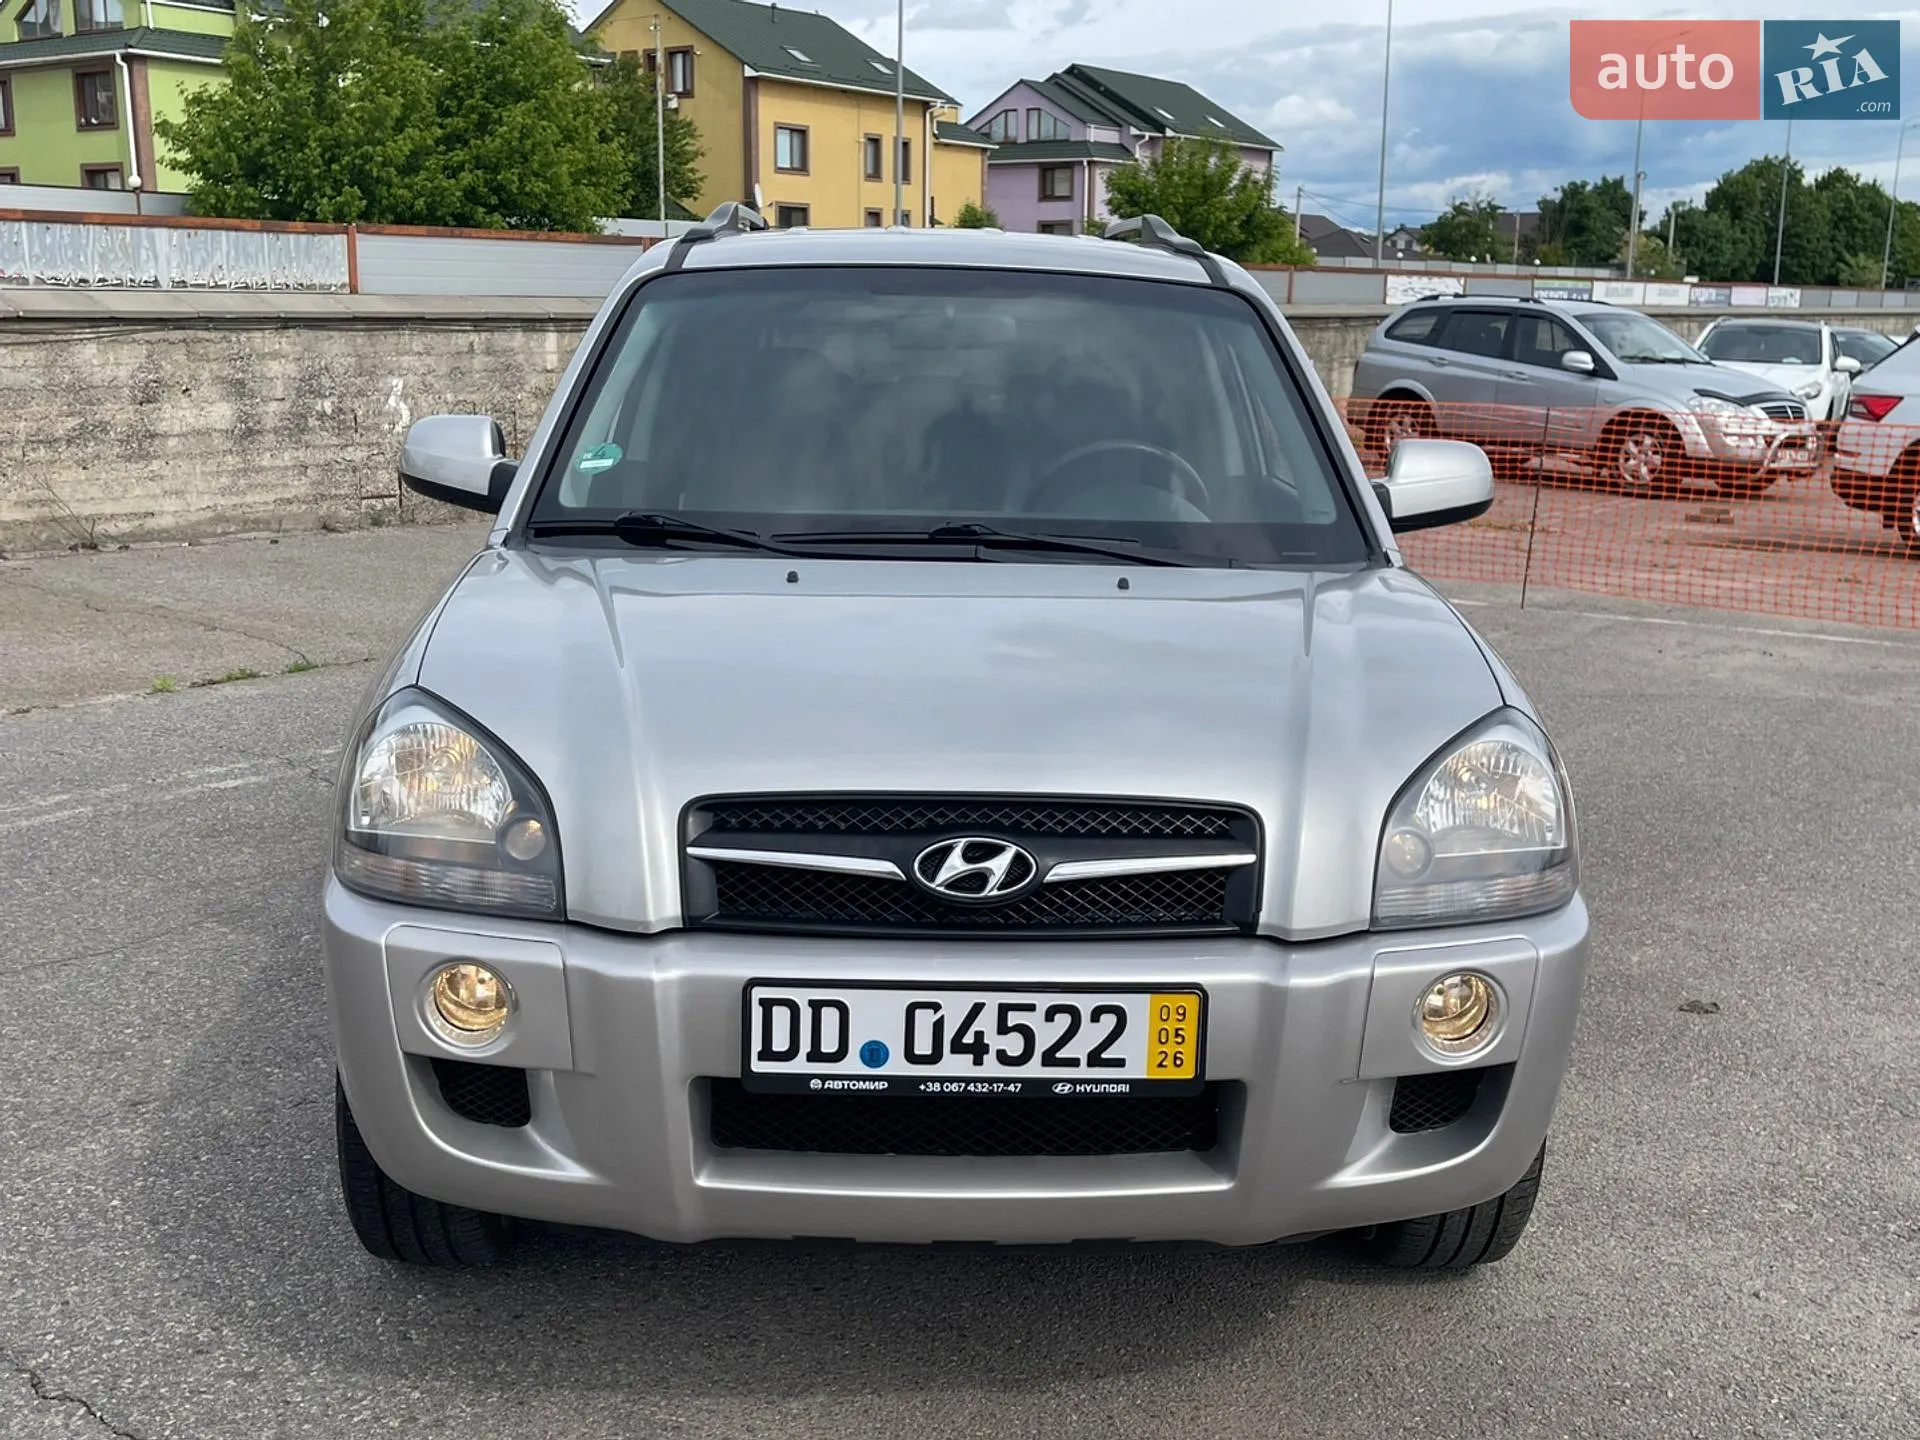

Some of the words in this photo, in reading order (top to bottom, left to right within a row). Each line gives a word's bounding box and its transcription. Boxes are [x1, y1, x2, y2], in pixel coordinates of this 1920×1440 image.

[1158, 1003, 1188, 1024] 09
[757, 997, 851, 1064] DD
[903, 1000, 1129, 1069] 04522
[1157, 1026, 1187, 1046] 05
[1156, 1049, 1185, 1070] 26
[823, 1079, 889, 1092] АВТОМИР
[918, 1081, 941, 1093] +38
[942, 1082, 967, 1093] 067
[968, 1082, 1023, 1094] 432-17-47
[1075, 1083, 1130, 1093] HYUNDAI
